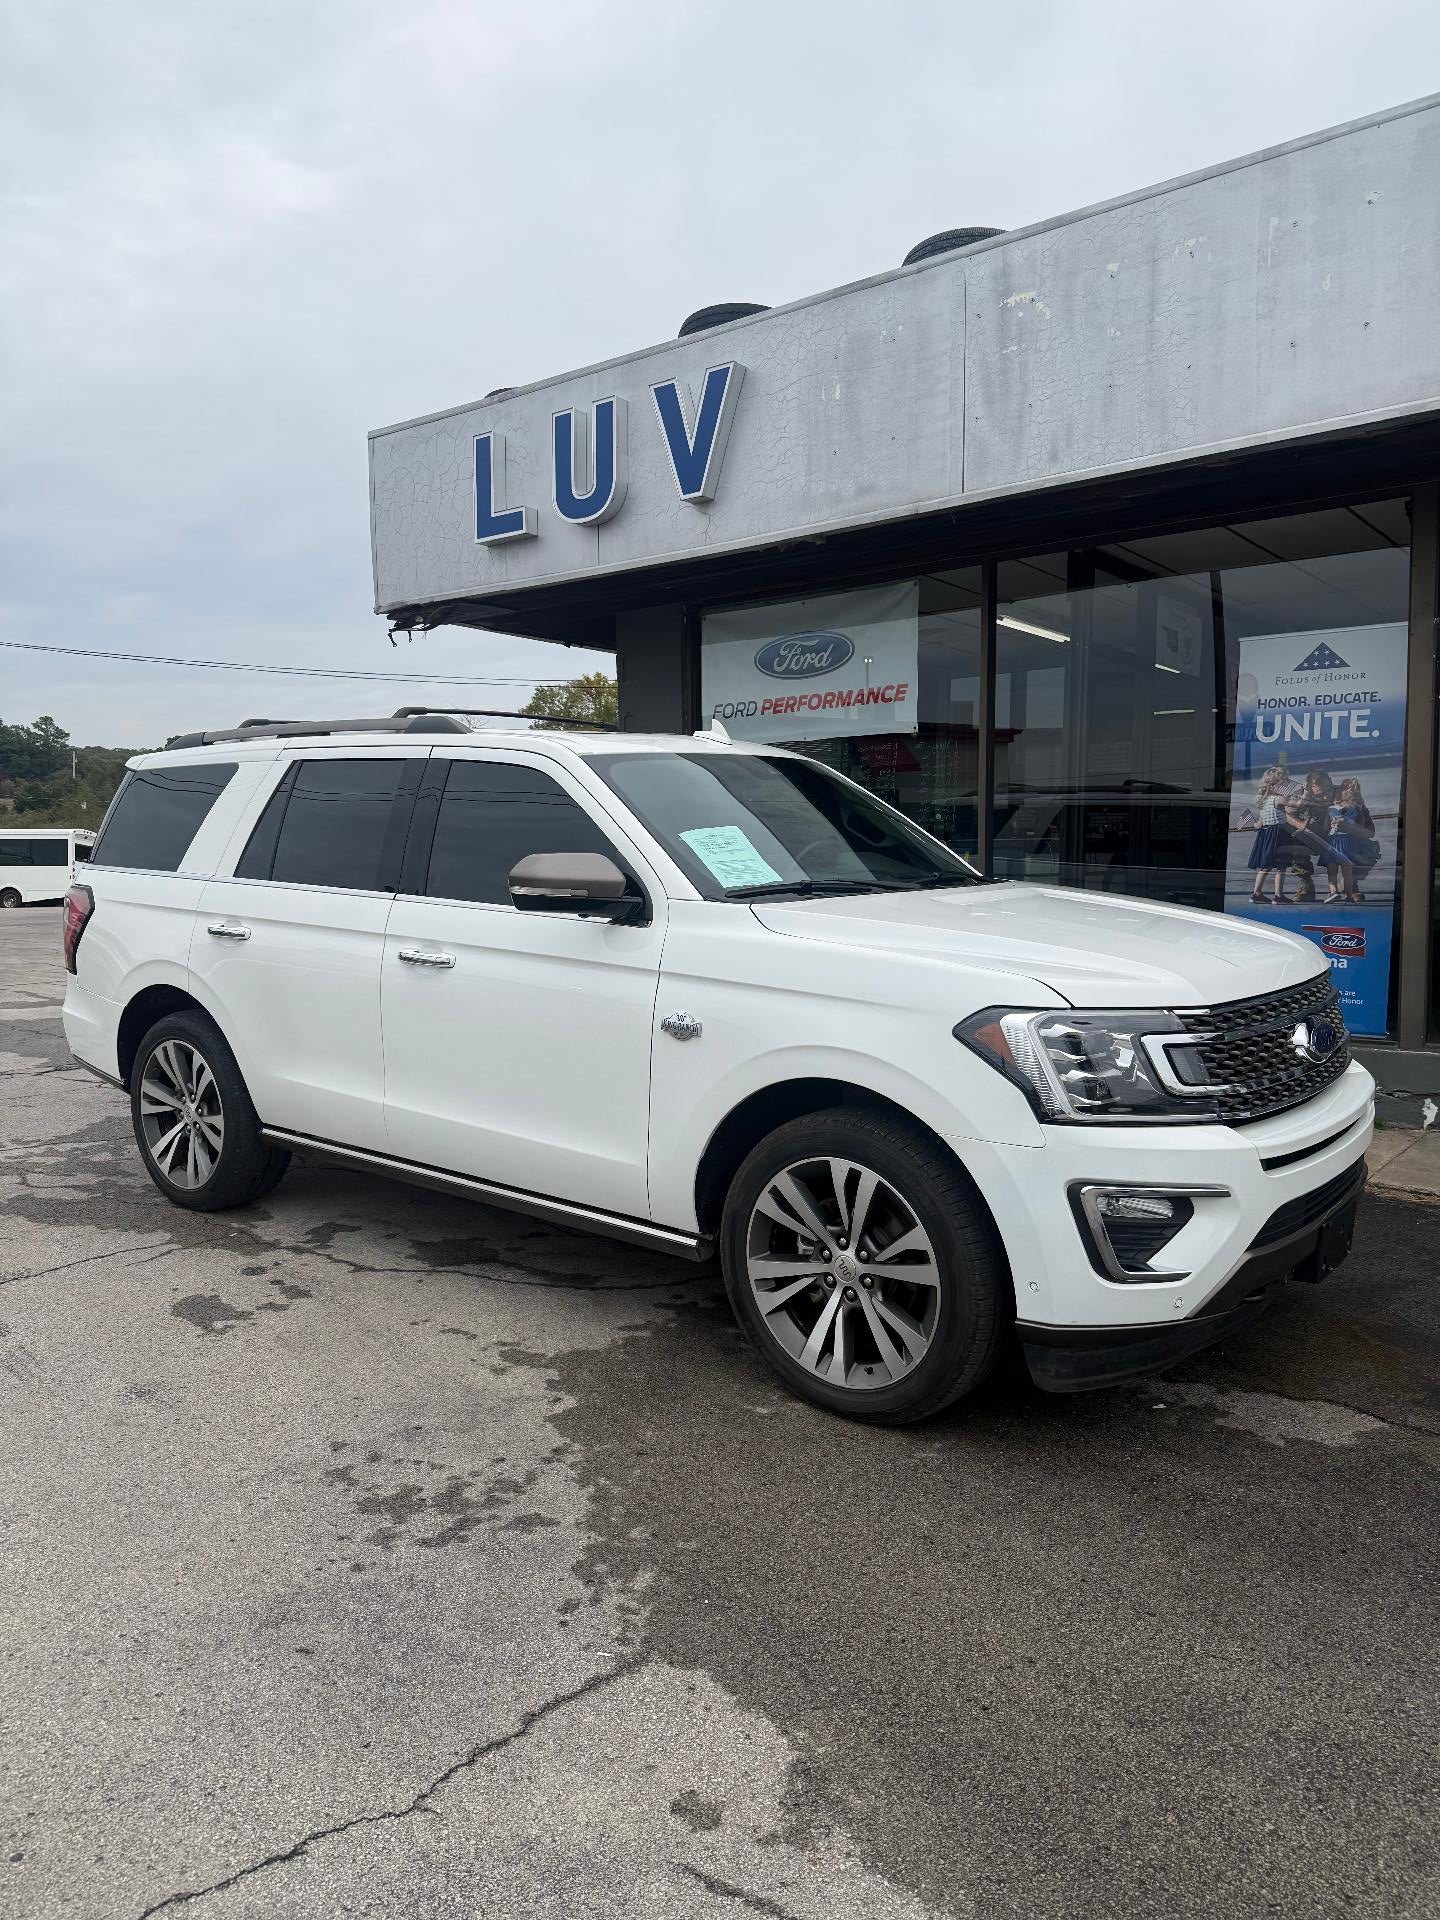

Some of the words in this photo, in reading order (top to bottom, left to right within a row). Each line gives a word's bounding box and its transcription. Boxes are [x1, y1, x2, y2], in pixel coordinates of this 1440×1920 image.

[774, 640, 832, 672] Ford
[713, 700, 758, 719] FORD
[760, 683, 909, 716] PERFORMANCE
[1257, 696, 1311, 709] HONOR.
[1314, 691, 1382, 706] EDUCATE.
[1255, 708, 1380, 744] UNITE.
[1328, 934, 1357, 947] Ford
[1341, 997, 1364, 1005] Honor
